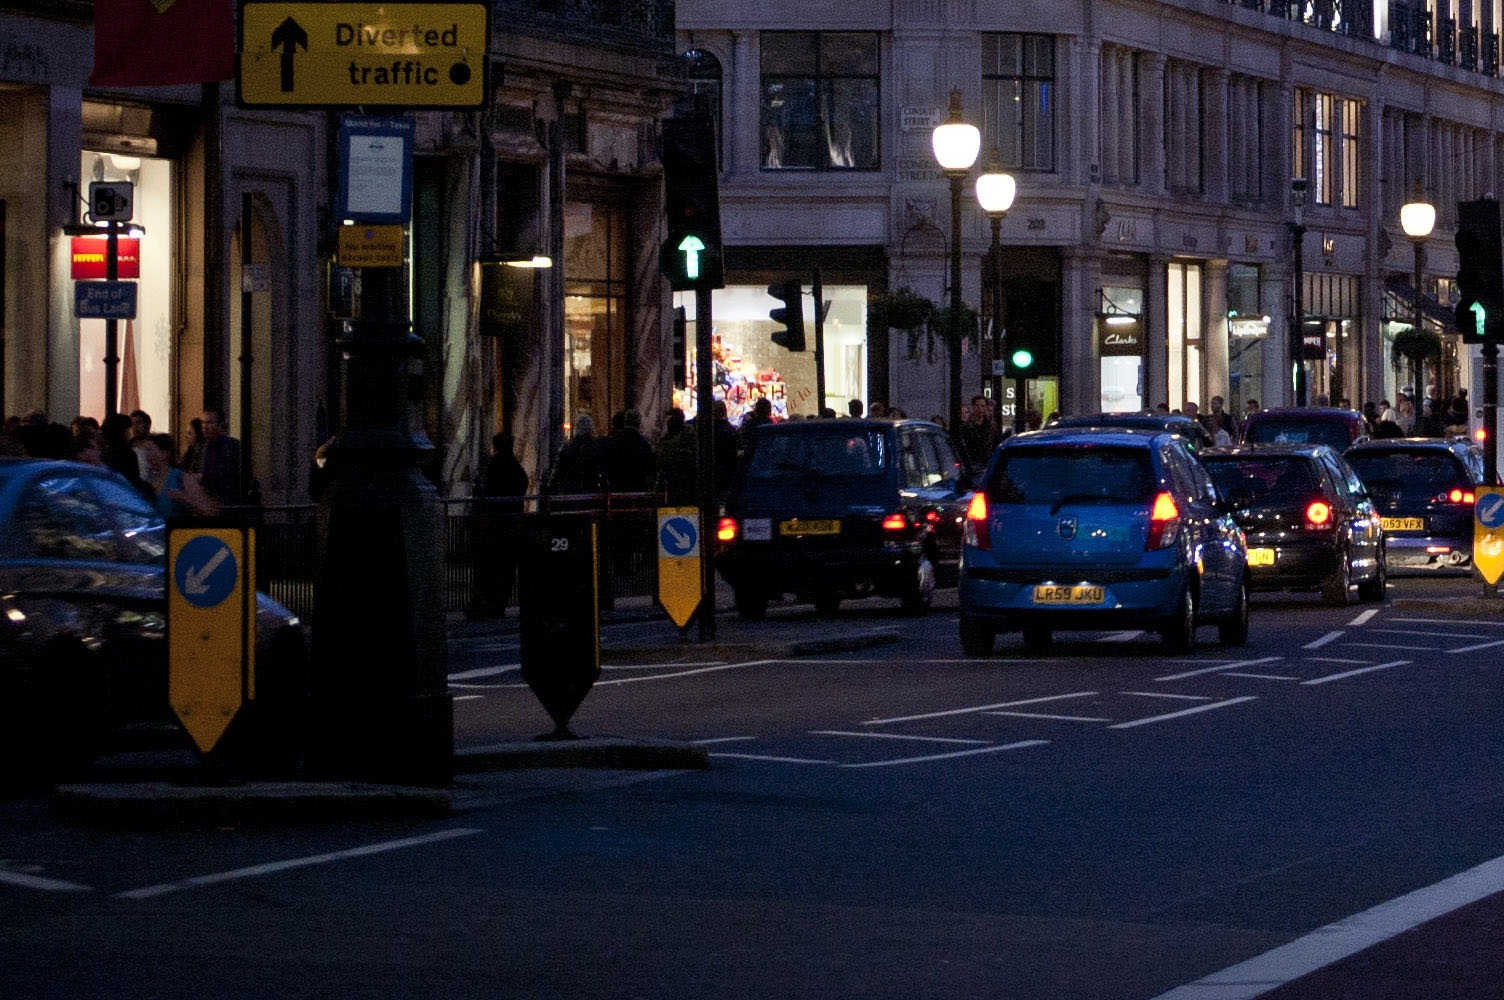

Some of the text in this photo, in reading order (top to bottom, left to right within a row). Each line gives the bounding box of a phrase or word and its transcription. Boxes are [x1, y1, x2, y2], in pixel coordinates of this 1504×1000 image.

[336, 23, 457, 47] Diverted
[348, 62, 438, 85] traffic
[1404, 517, 1423, 528] VFX
[551, 537, 569, 552] 29
[1036, 587, 1103, 601] LR59 JKU
